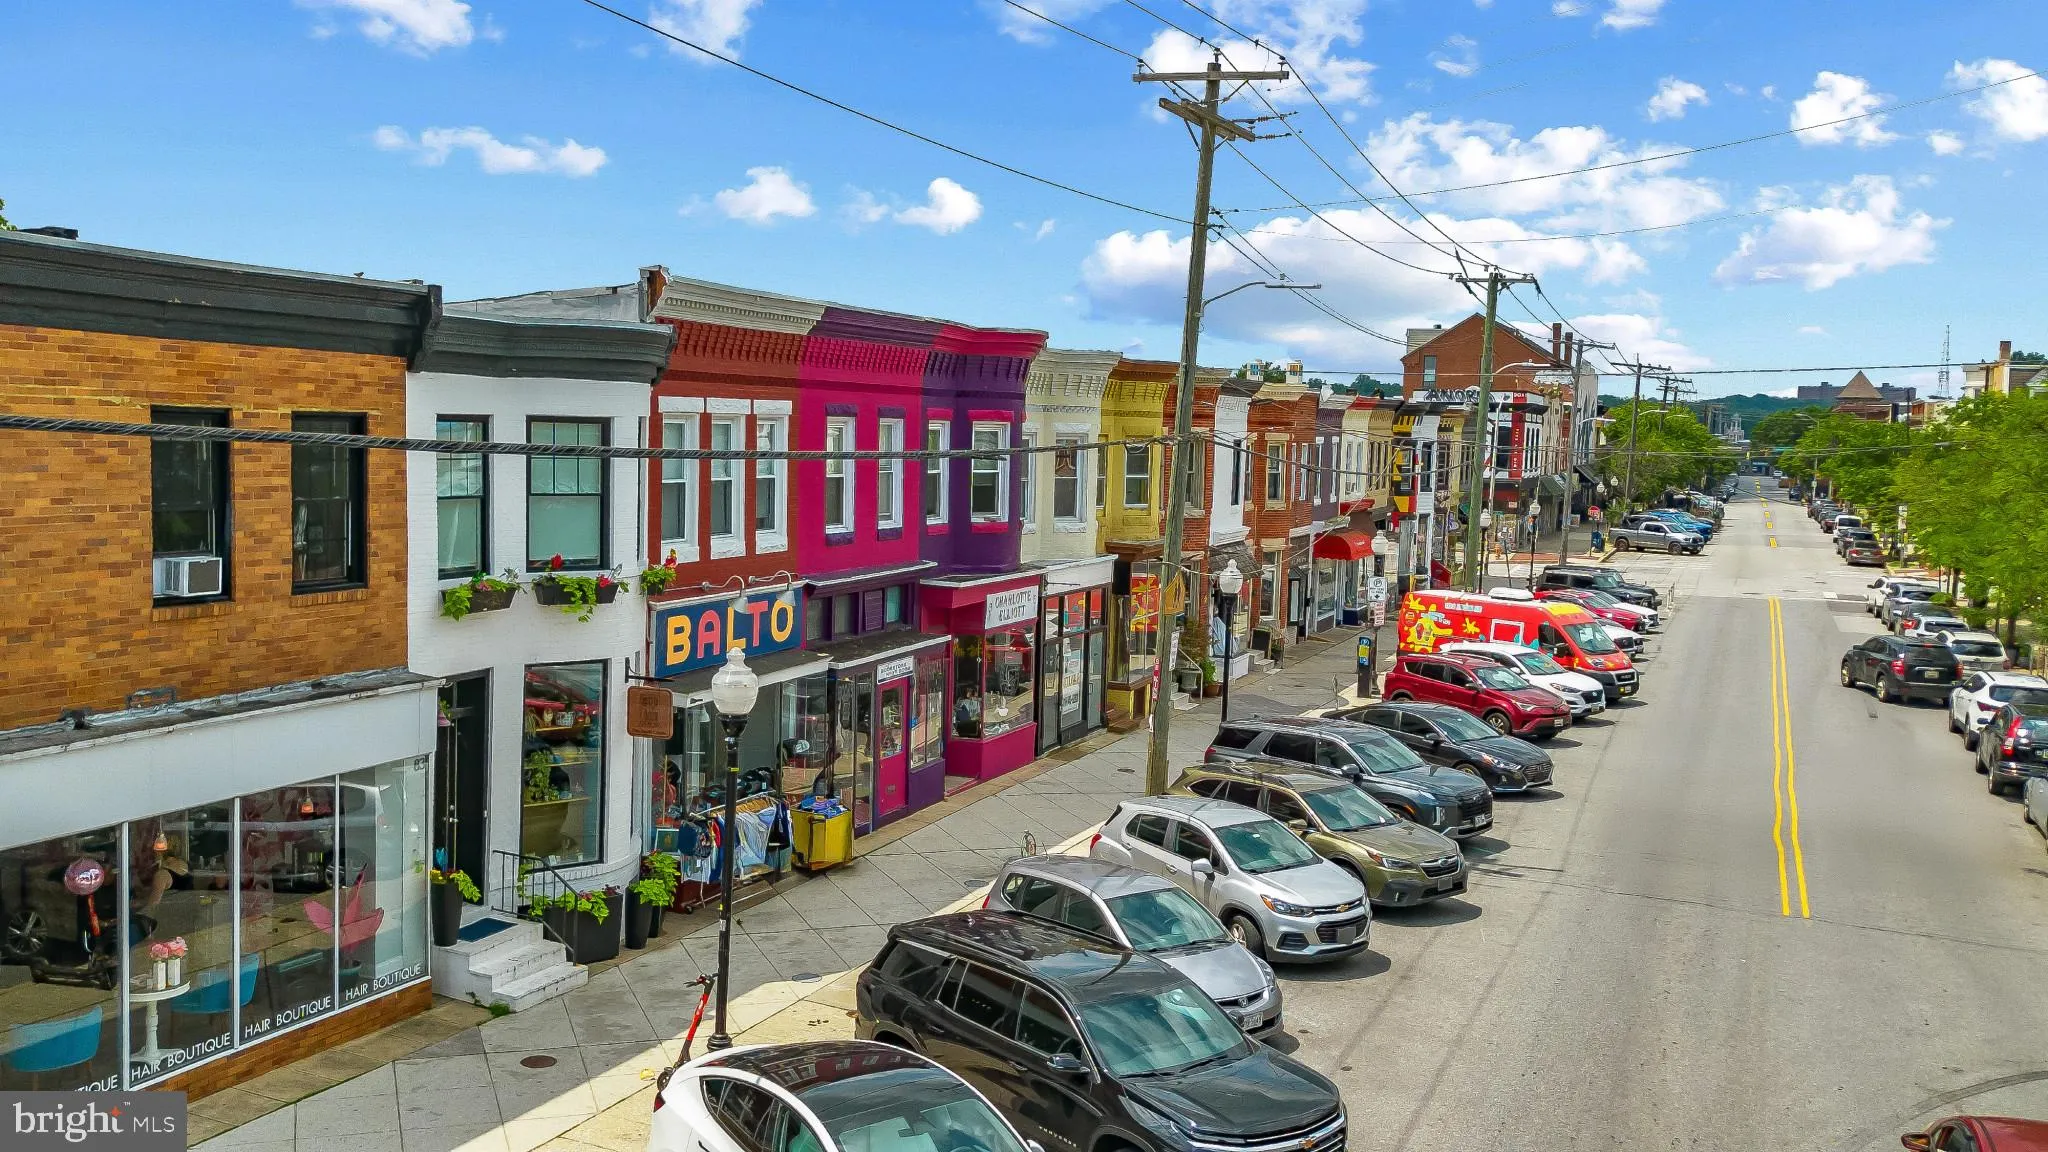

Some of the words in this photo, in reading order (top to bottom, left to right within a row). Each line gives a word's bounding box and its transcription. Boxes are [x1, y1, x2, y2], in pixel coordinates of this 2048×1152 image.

[995, 590, 1031, 608] CHARLOTTE
[999, 605, 1026, 621] ELLIOTT
[666, 599, 794, 666] BALTO
[346, 983, 368, 1001] HAIR
[373, 963, 421, 991] BOUTIQUE
[244, 1018, 271, 1039] HAIR
[276, 995, 331, 1026] BOUTIQUE
[131, 1061, 161, 1081] HAIR
[167, 1032, 231, 1068] BOUTIQUE
